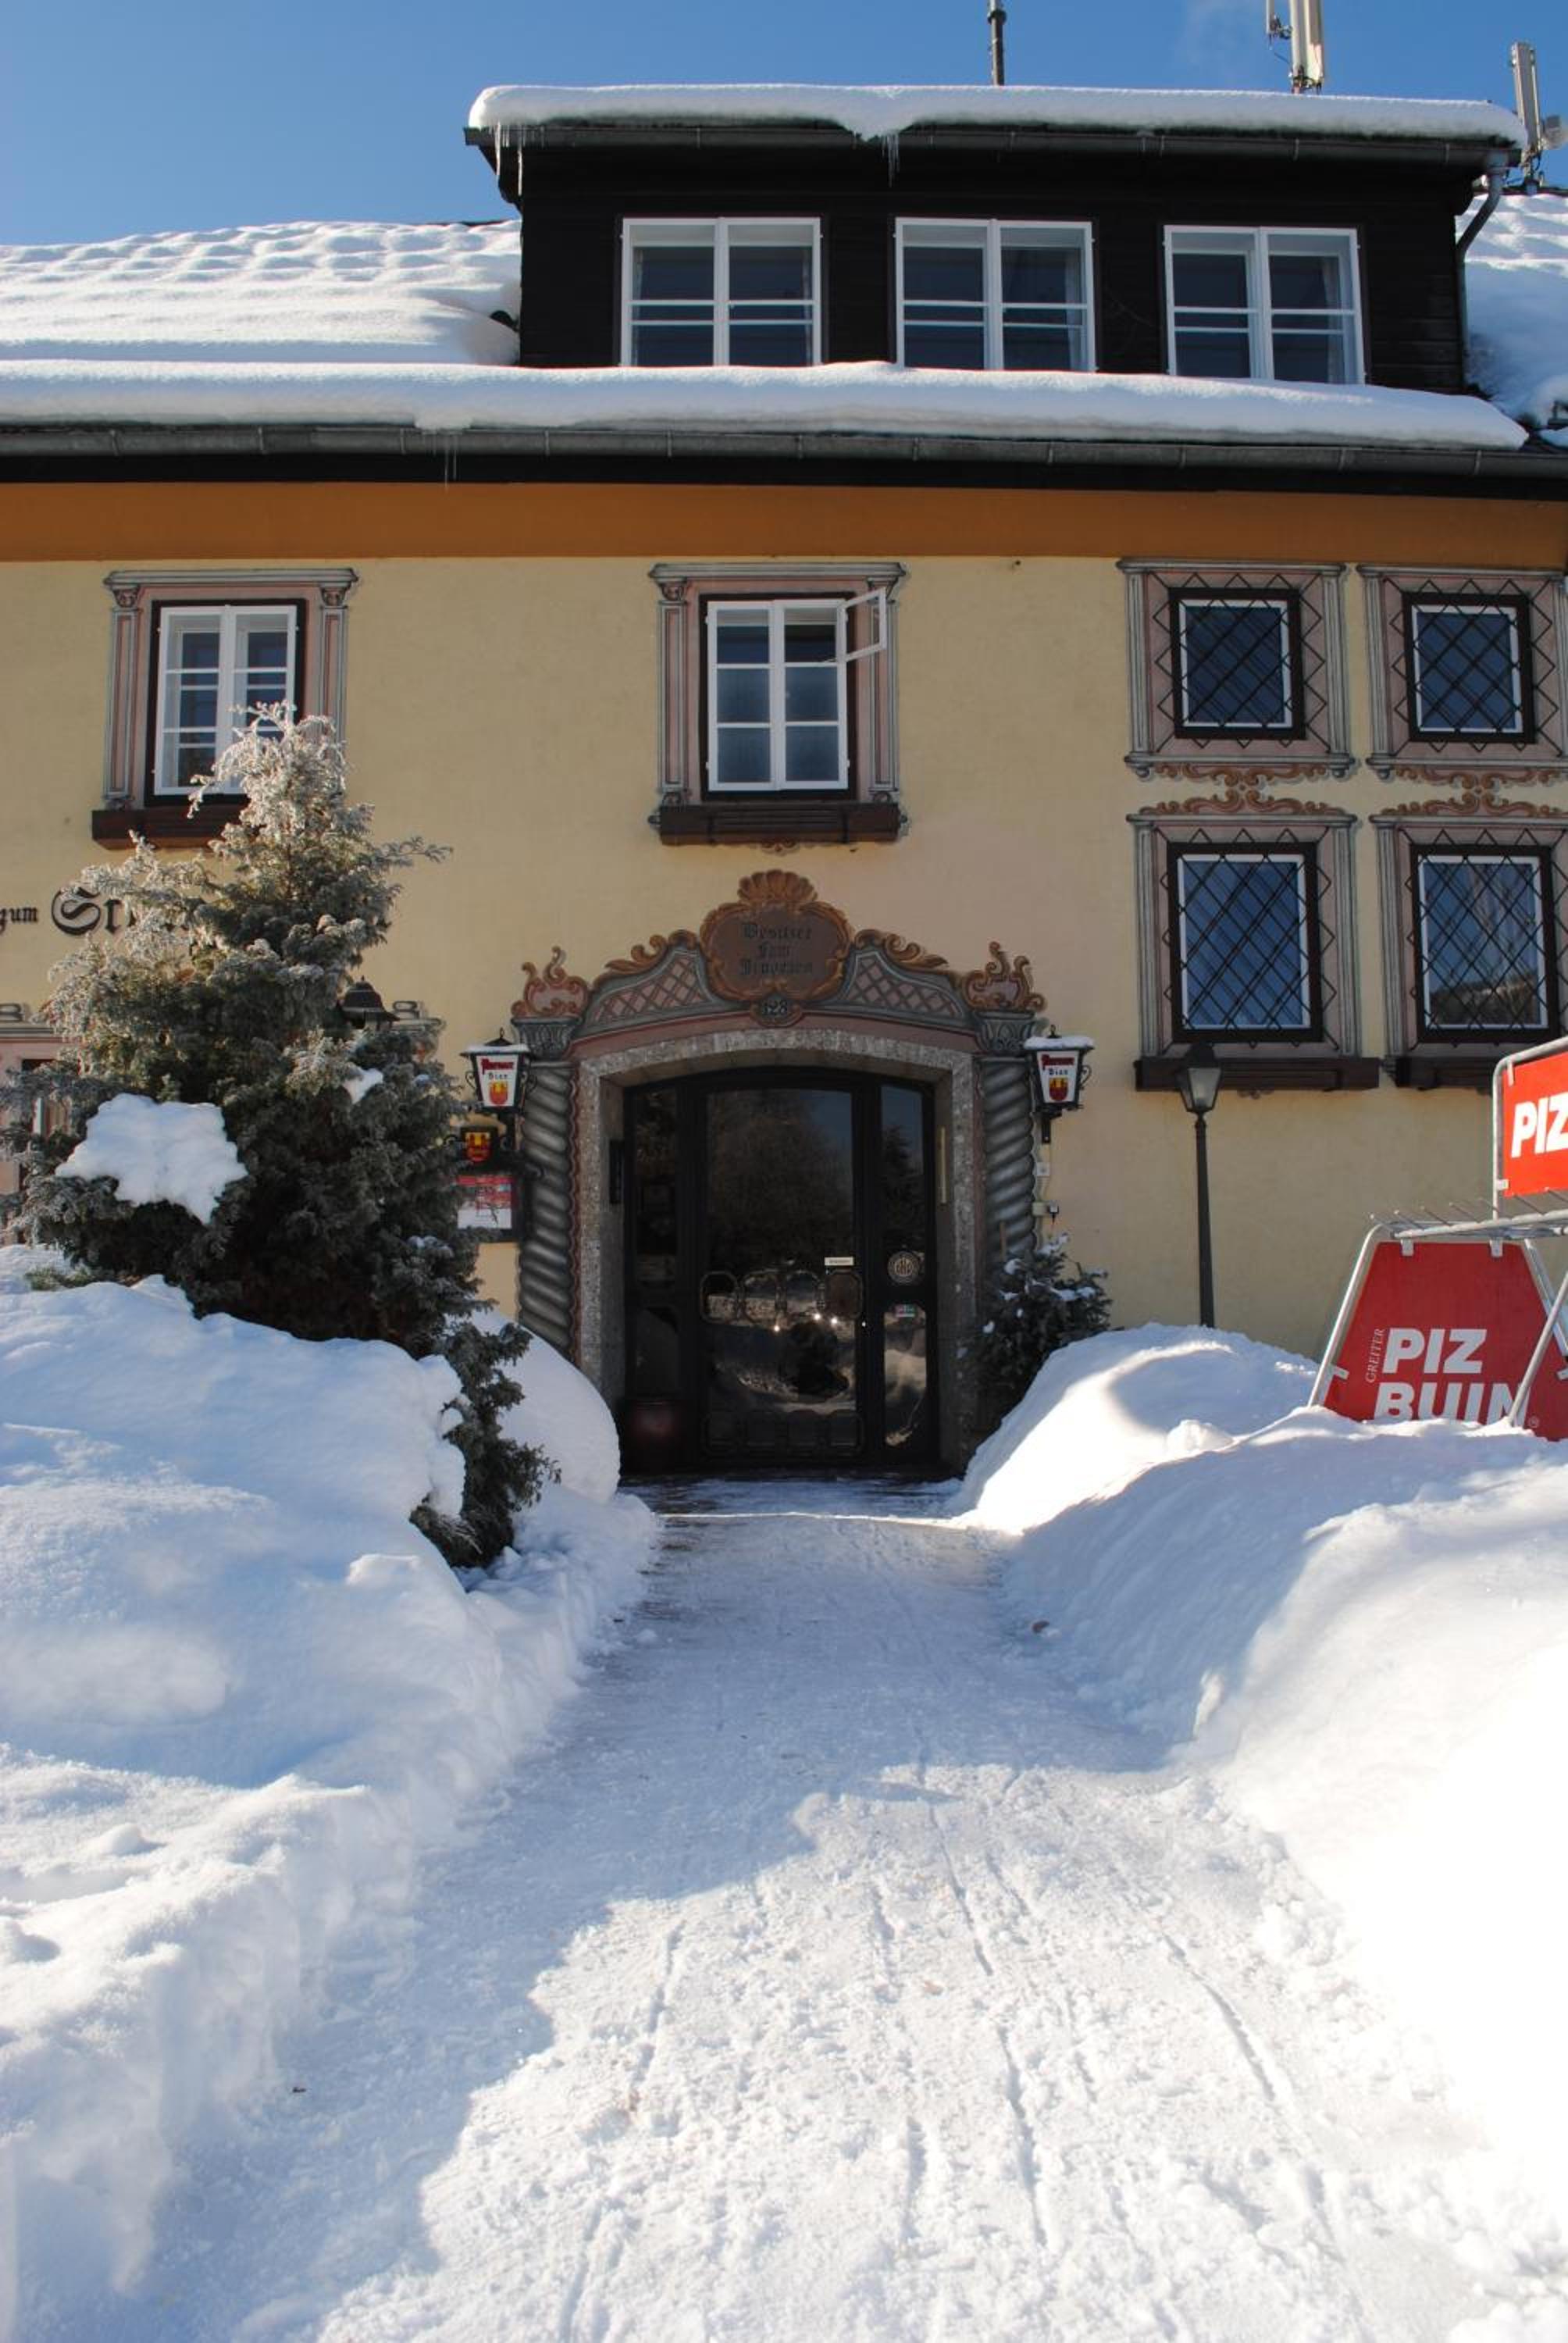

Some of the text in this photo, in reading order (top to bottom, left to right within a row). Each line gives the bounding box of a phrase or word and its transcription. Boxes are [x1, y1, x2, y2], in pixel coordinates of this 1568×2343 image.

[1511, 1092, 1568, 1157] PIZ
[1367, 1328, 1385, 1383] GREITER
[1382, 1328, 1487, 1373] PIZ
[1374, 1382, 1531, 1426] BUIN
